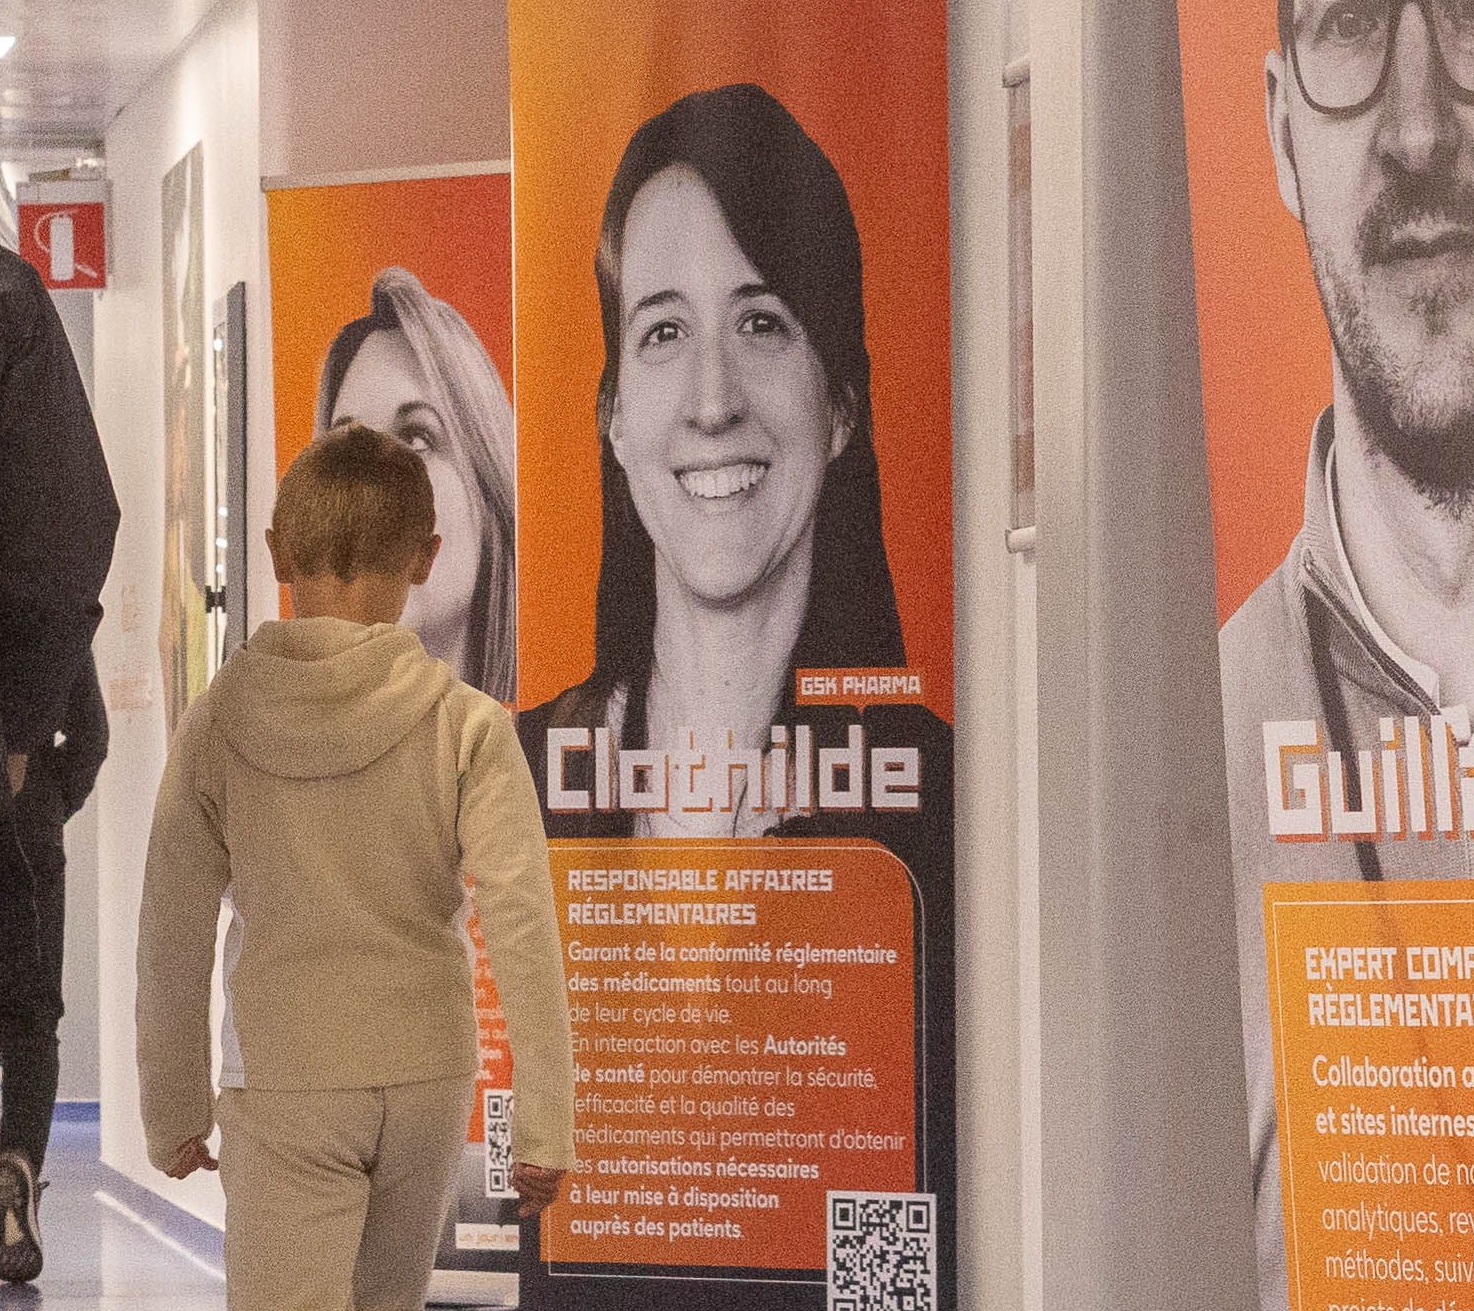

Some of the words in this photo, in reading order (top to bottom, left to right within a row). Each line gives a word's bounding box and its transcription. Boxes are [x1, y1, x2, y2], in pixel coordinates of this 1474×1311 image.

[801, 676, 837, 695] GSK
[841, 676, 921, 695] PHARMA
[547, 725, 920, 813] Clothilde
[568, 869, 717, 891] RESPONSABLE
[725, 869, 833, 891] AFFAIRES
[568, 897, 756, 925] RÉGLEMENTAIRES
[568, 942, 630, 963] Garant
[635, 943, 656, 962] de
[660, 943, 676, 962] la
[679, 943, 771, 963] conformité
[776, 943, 896, 968] réglementaire
[1305, 947, 1397, 980] EXPERT
[568, 974, 599, 992] des
[604, 972, 721, 993] médicaments
[725, 975, 761, 993] tout
[766, 978, 788, 993] au
[793, 972, 832, 998] long
[569, 1003, 590, 1023] de
[595, 1002, 627, 1023] leur
[632, 1004, 675, 1028] cycle
[679, 1003, 701, 1023] de
[705, 1007, 732, 1024] vie.
[594, 1035, 686, 1054] interaction
[691, 1039, 732, 1055] avec
[736, 1036, 759, 1054] les
[764, 1034, 846, 1056] Autorités
[596, 1063, 644, 1083] santé
[650, 1069, 687, 1088] pour
[691, 1066, 781, 1085] démontrer
[786, 1066, 803, 1085] la
[1312, 1055, 1456, 1089] Collaboration
[659, 1095, 676, 1115] et
[680, 1097, 697, 1115] la
[701, 1095, 759, 1123] qualité
[764, 1098, 795, 1117] des
[1316, 1108, 1336, 1136] et
[1341, 1104, 1386, 1137] sites
[689, 1129, 715, 1150] qui
[720, 1131, 825, 1151] permettront
[829, 1130, 906, 1151] d'obtenir
[573, 1159, 593, 1173] es
[598, 1156, 712, 1177] autorisations
[716, 1156, 819, 1180] nécessaires
[1319, 1153, 1417, 1185] validation
[1423, 1155, 1450, 1186] de
[570, 1183, 581, 1204] à
[586, 1184, 620, 1206] leur
[623, 1184, 663, 1206] mise
[667, 1185, 679, 1206] à
[683, 1187, 779, 1211] disposition
[570, 1216, 630, 1240] auprès
[635, 1216, 665, 1238] des
[669, 1218, 744, 1242] patients.
[1322, 1202, 1442, 1241] analytiques,
[1325, 1249, 1429, 1283] méthodes,
